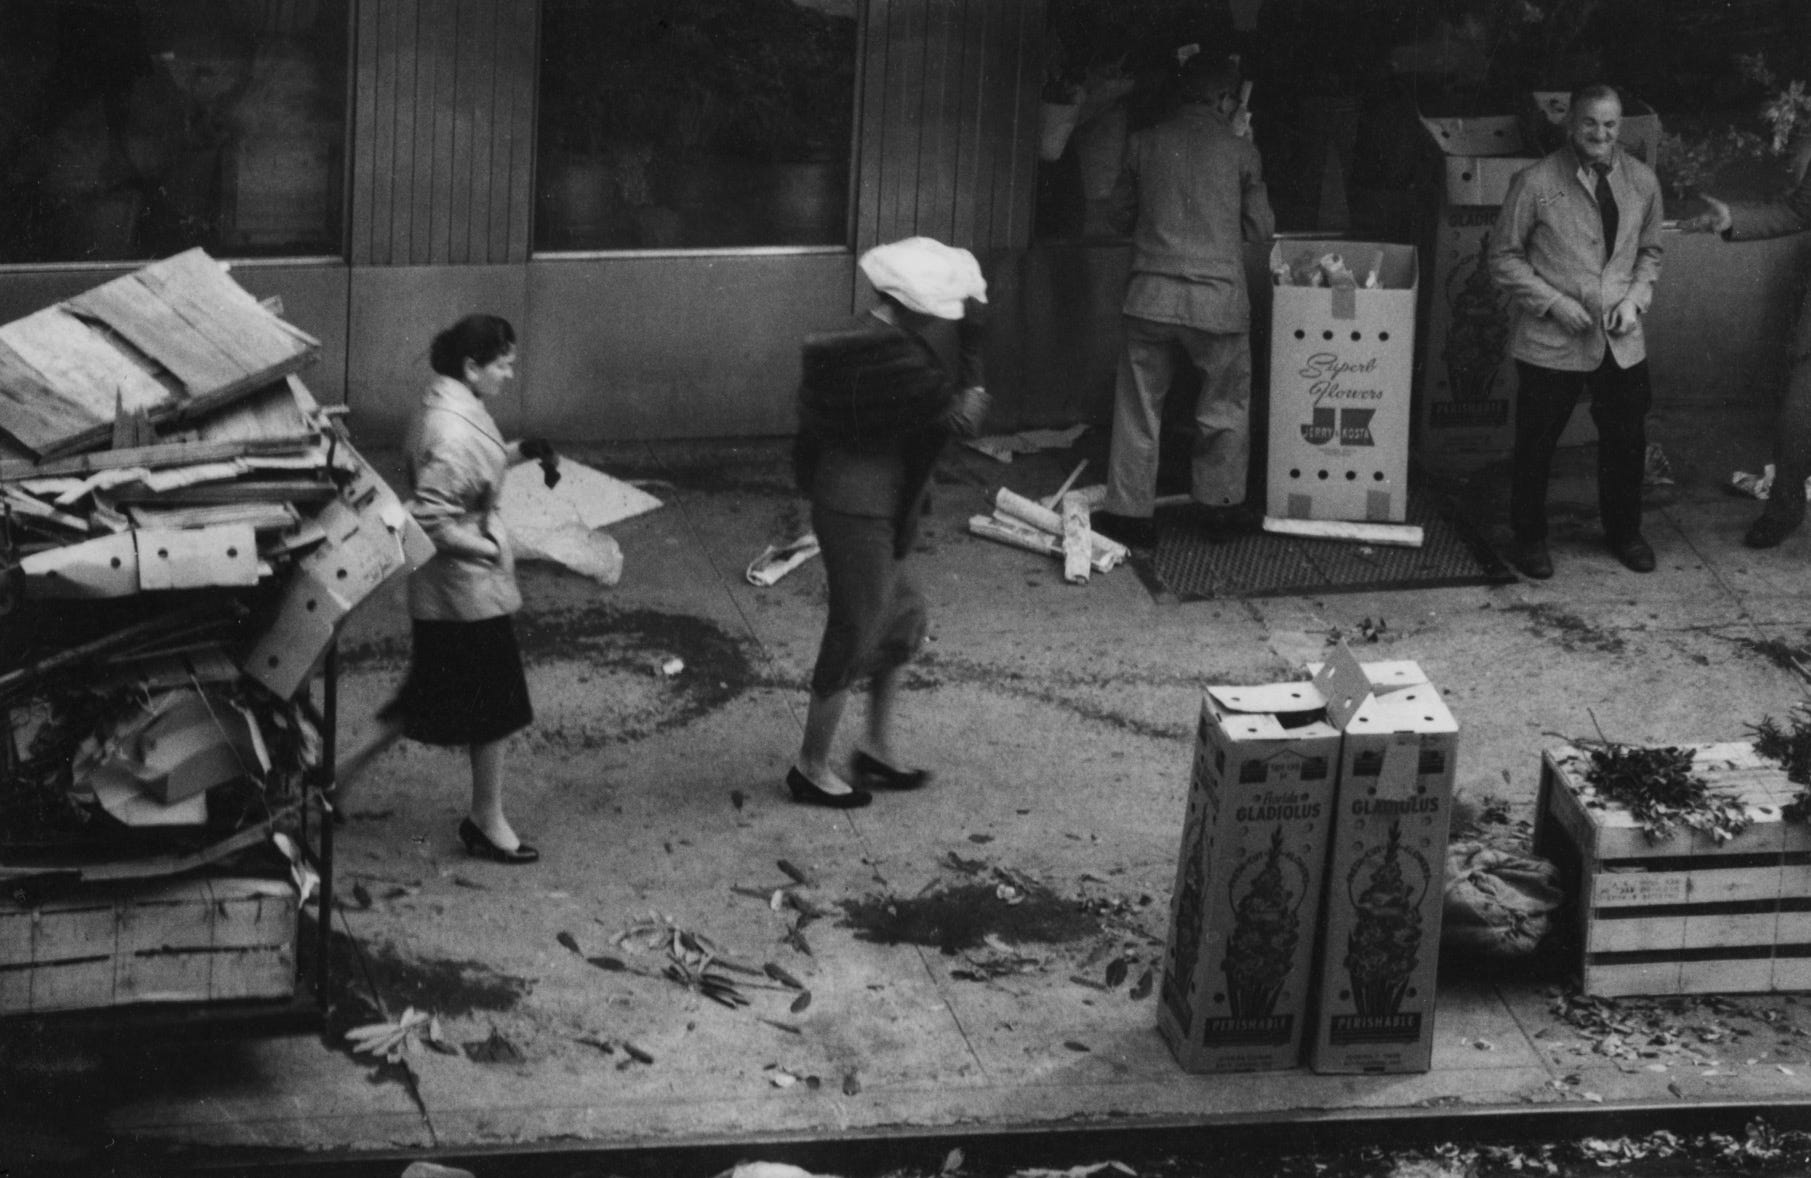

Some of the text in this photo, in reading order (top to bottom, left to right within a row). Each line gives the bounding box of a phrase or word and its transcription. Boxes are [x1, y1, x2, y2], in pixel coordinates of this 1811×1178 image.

[1299, 352, 1377, 381] Superb
[1308, 380, 1384, 407] Flowers
[1341, 427, 1370, 440] KOSTA
[1235, 802, 1321, 823] GLADIOLUS
[1211, 1017, 1289, 1033] PERISHABLE
[1336, 1015, 1416, 1031] PERISHABLE
